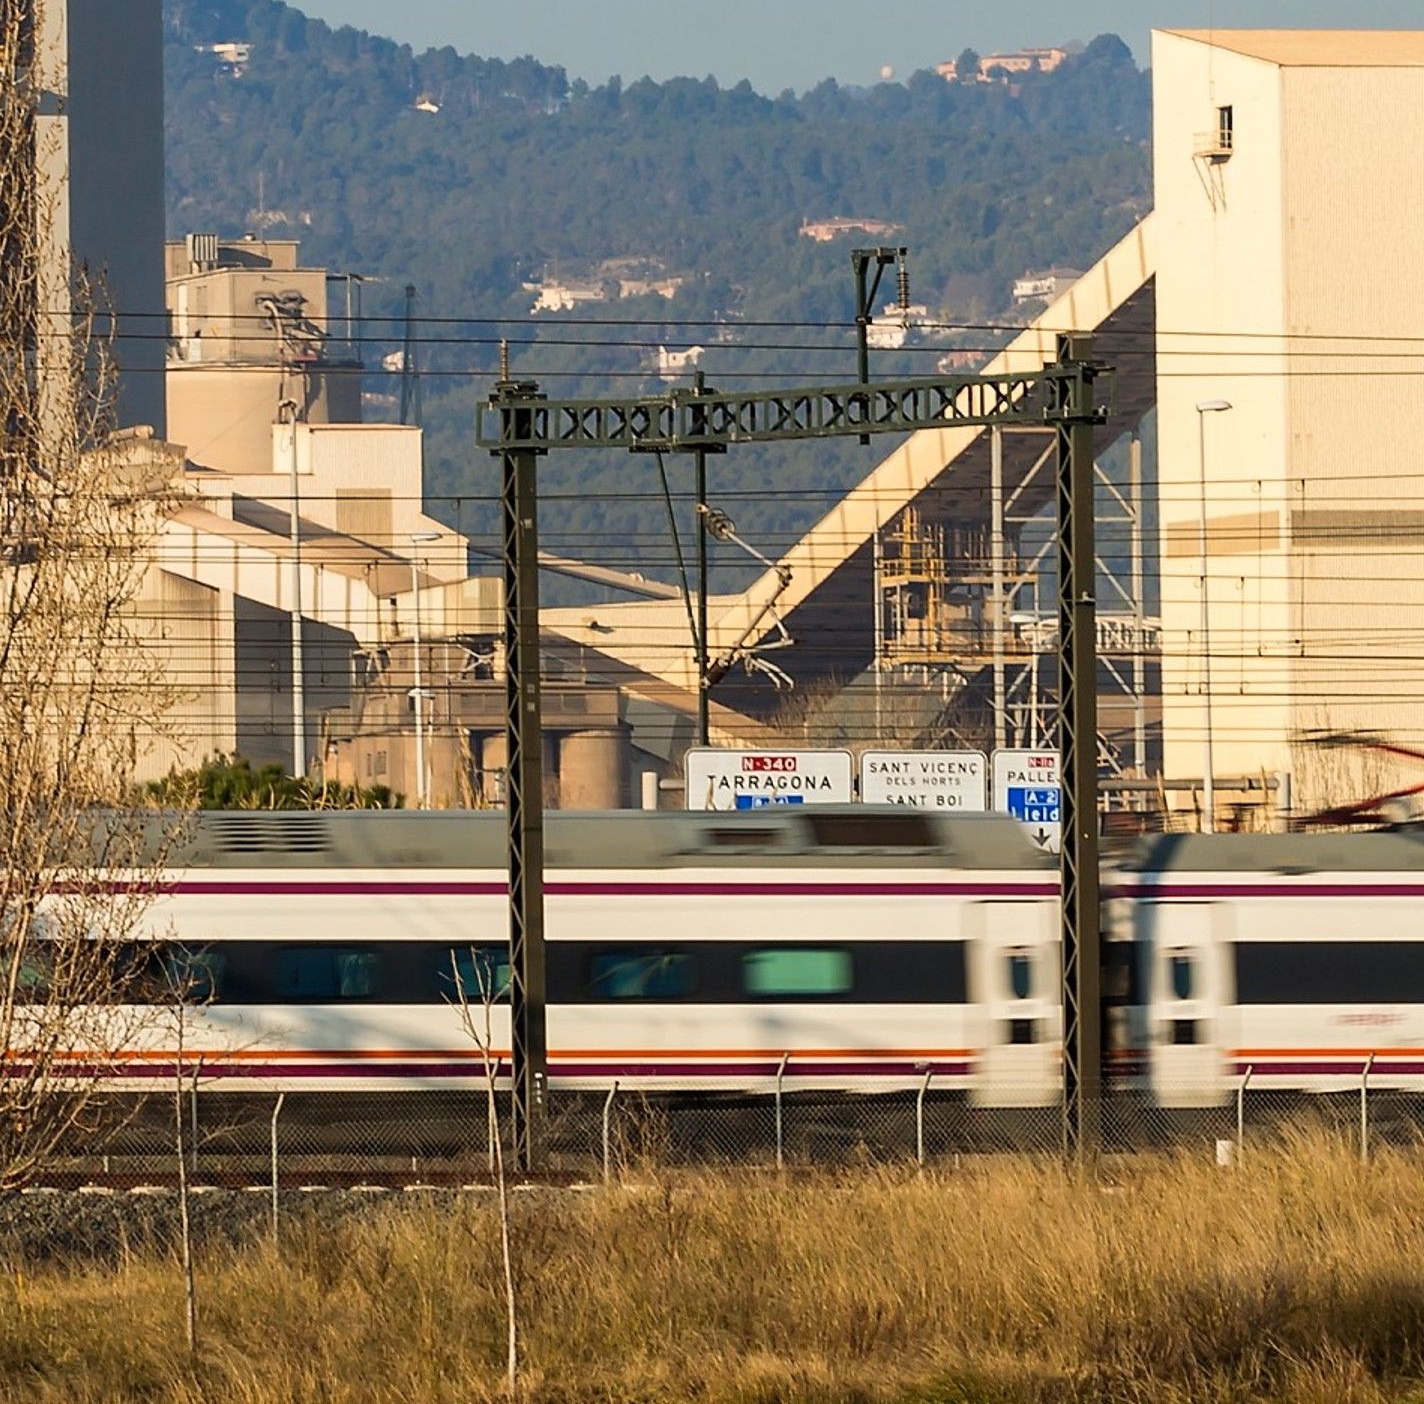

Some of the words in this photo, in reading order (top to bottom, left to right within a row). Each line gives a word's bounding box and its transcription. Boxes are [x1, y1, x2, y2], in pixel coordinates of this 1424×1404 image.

[743, 757, 796, 771] N-340
[870, 762, 910, 773] SANT
[920, 762, 978, 775] VICENÇ
[707, 775, 832, 790] TARRAGONA
[886, 777, 916, 786] DELS
[922, 777, 961, 786] HORTS
[1007, 771, 1061, 783] PALLE
[886, 795, 926, 806] SANT
[936, 795, 962, 806] BOI
[1027, 790, 1055, 804] A-2
